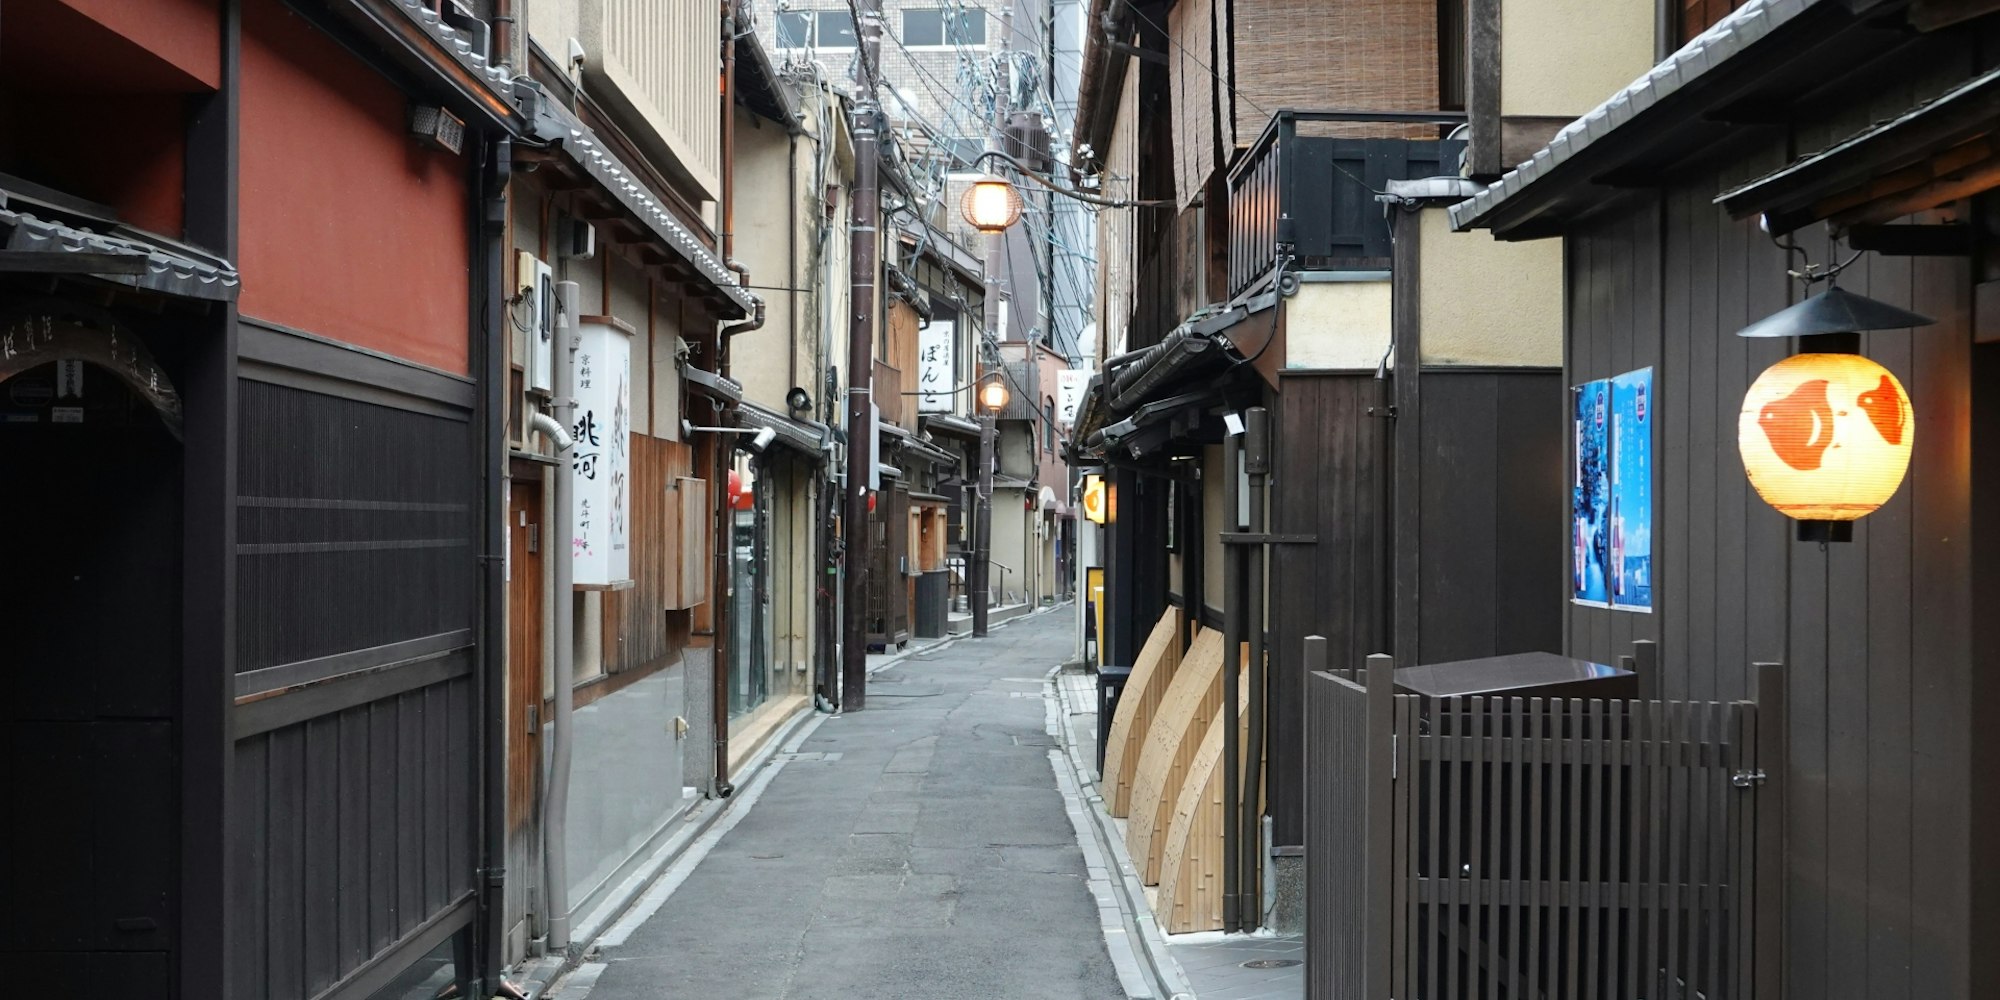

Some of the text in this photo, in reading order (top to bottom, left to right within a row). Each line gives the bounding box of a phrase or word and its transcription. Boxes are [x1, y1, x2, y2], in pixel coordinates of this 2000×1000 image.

[580, 354, 592, 389] 京料理
[921, 344, 941, 403] ぽんと
[573, 410, 601, 480] 眺河
